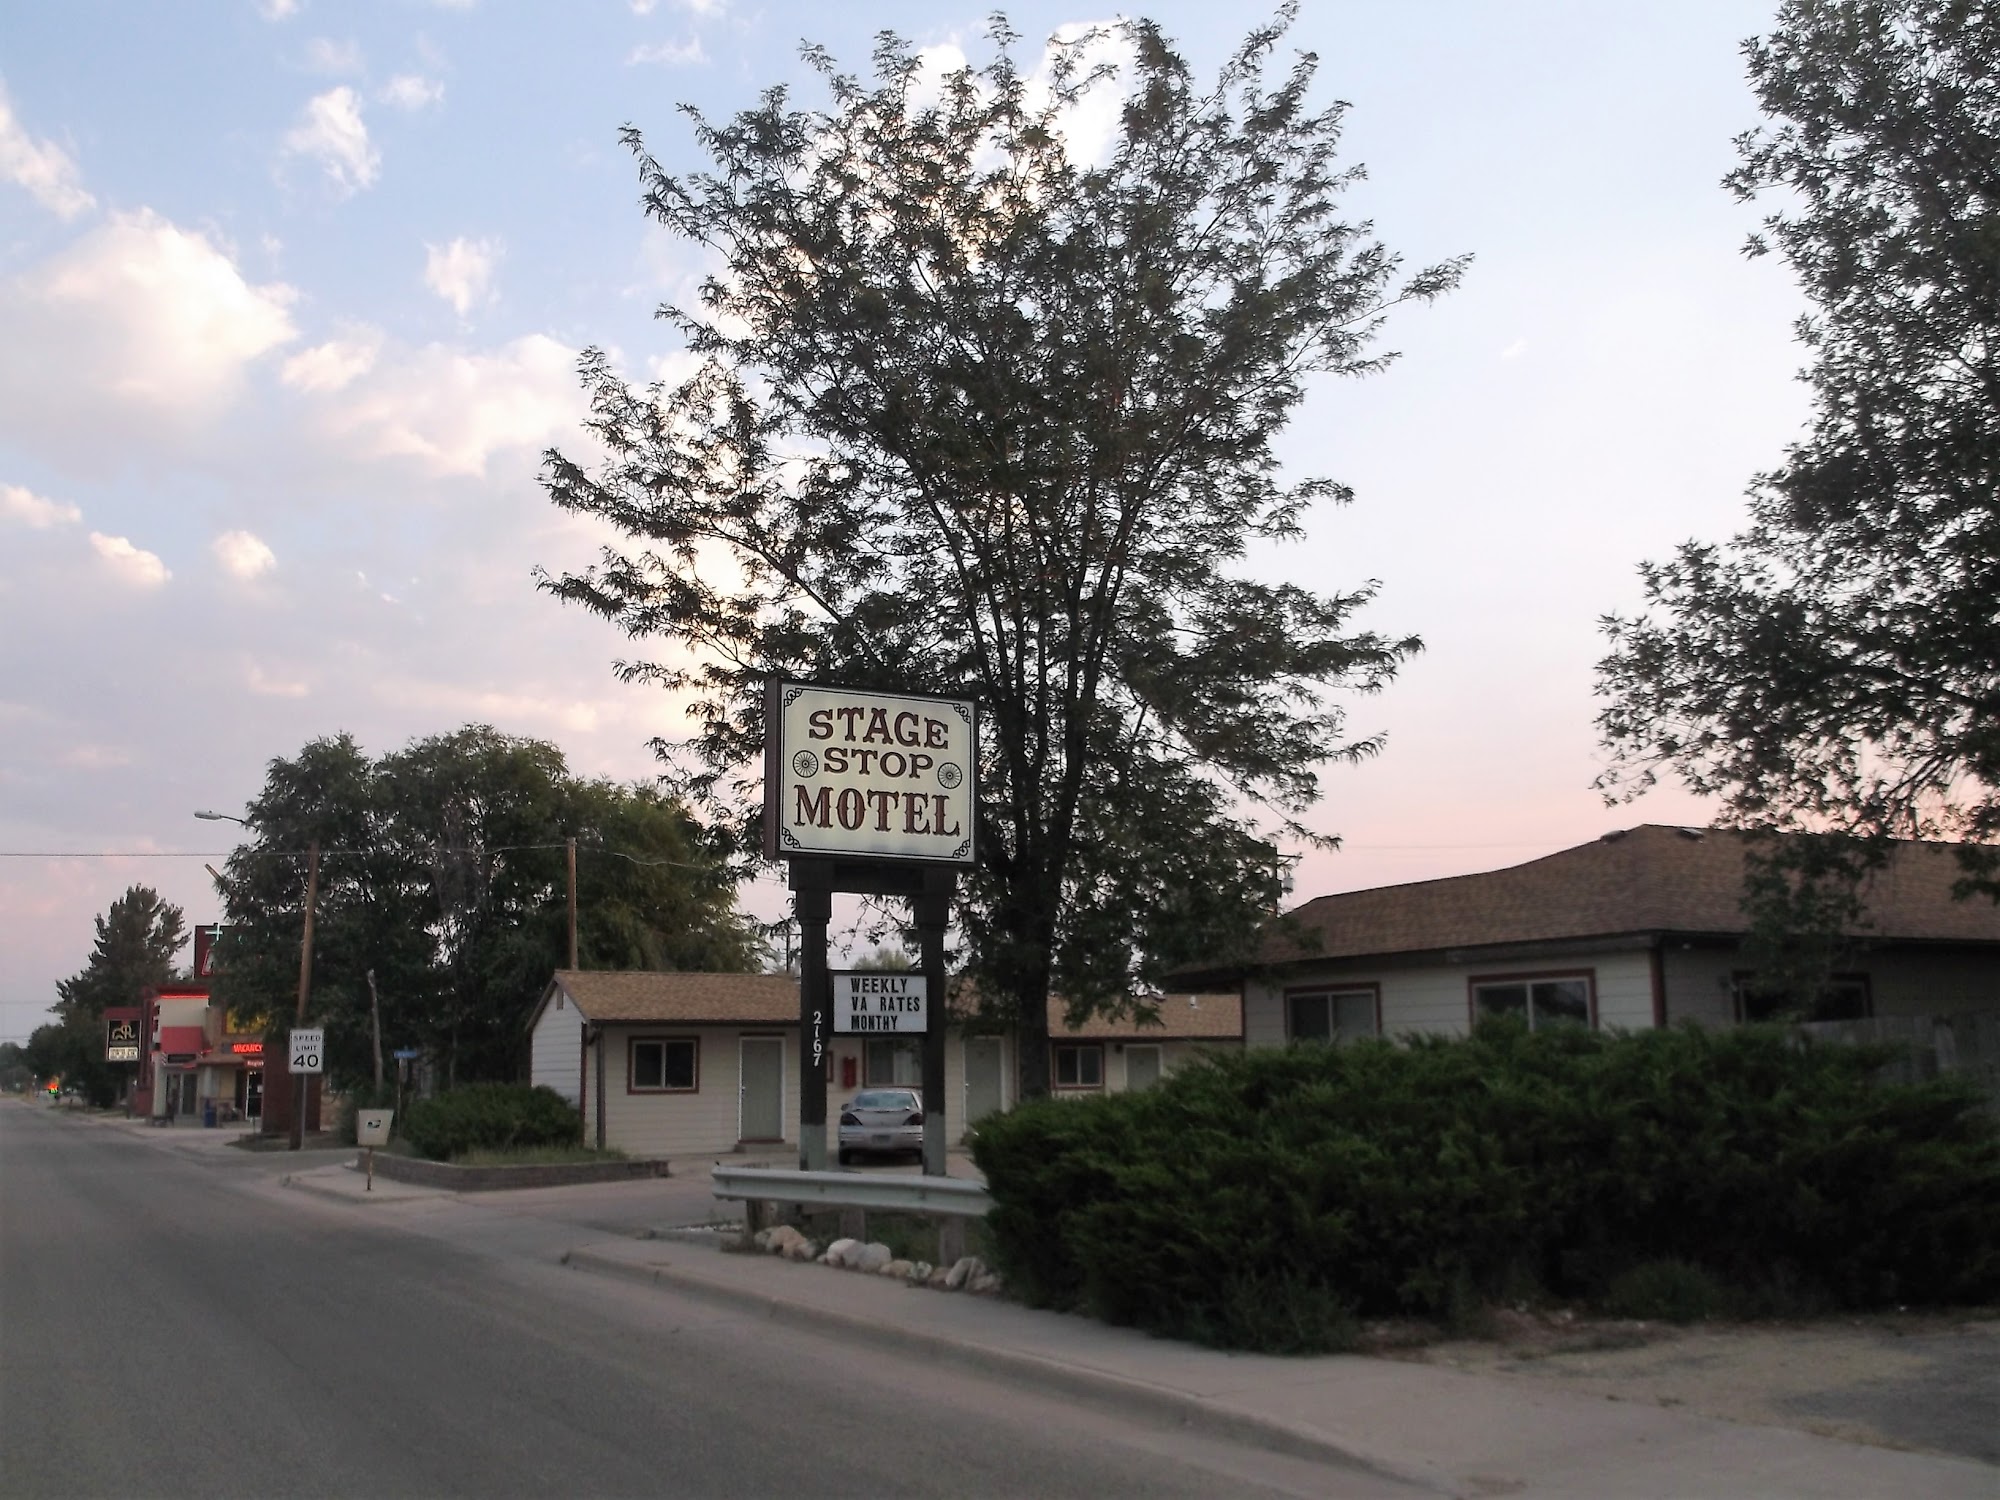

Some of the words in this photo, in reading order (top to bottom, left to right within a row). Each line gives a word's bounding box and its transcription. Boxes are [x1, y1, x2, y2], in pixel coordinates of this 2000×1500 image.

[808, 707, 948, 749] STAGE
[823, 747, 933, 779] STOP
[793, 784, 960, 837] MOTEL
[850, 978, 907, 993] WEEKLY
[851, 996, 867, 1011] VA
[880, 996, 920, 1011] RATES
[851, 1015, 898, 1030] MONTHY
[813, 1010, 822, 1067] 2167
[293, 1054, 319, 1068] 40
